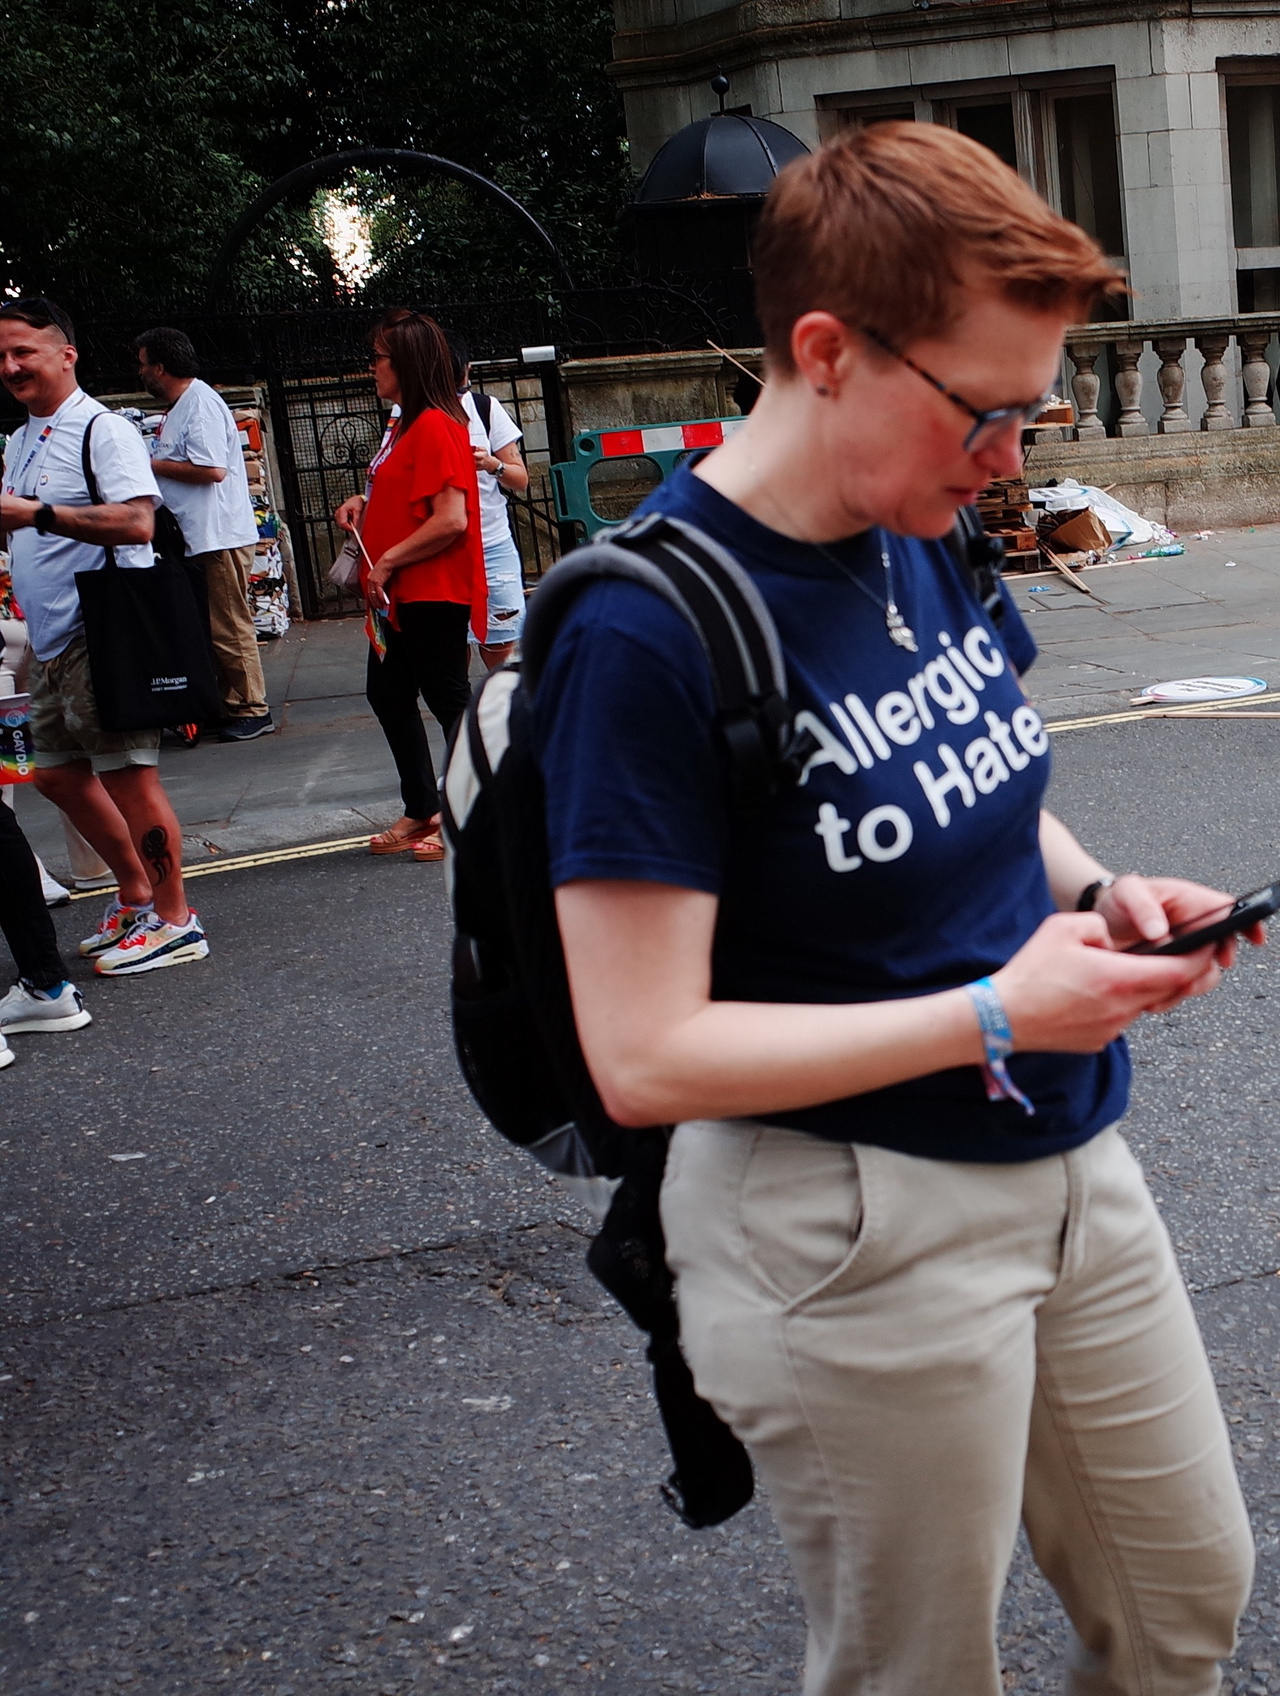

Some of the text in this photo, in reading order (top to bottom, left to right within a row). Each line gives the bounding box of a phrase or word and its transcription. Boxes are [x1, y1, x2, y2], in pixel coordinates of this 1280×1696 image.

[12, 729, 29, 776] GAYDIO
[794, 626, 1005, 787] Allergic
[814, 705, 1049, 873] to Hate
